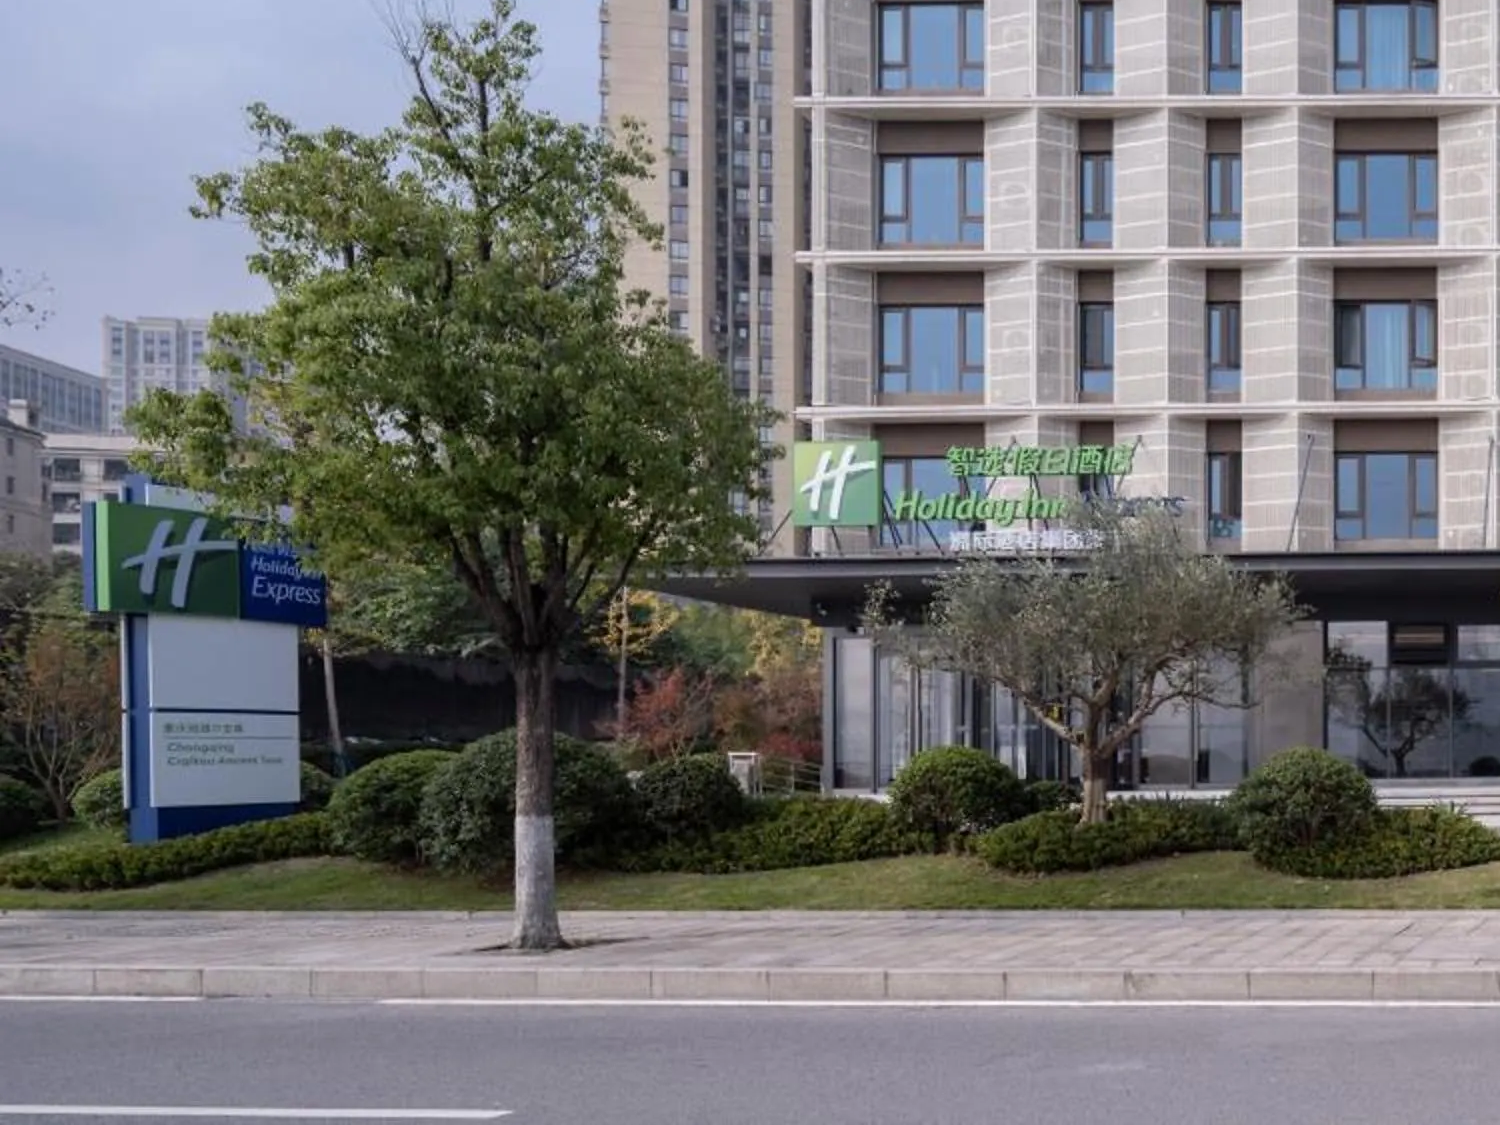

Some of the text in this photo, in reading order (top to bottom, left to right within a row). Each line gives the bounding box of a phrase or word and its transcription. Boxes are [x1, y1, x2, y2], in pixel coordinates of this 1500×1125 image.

[947, 444, 1134, 476] 智选假日酒店
[894, 489, 1019, 527] Holiday
[251, 555, 303, 581] Holiday
[251, 575, 321, 606] Express
